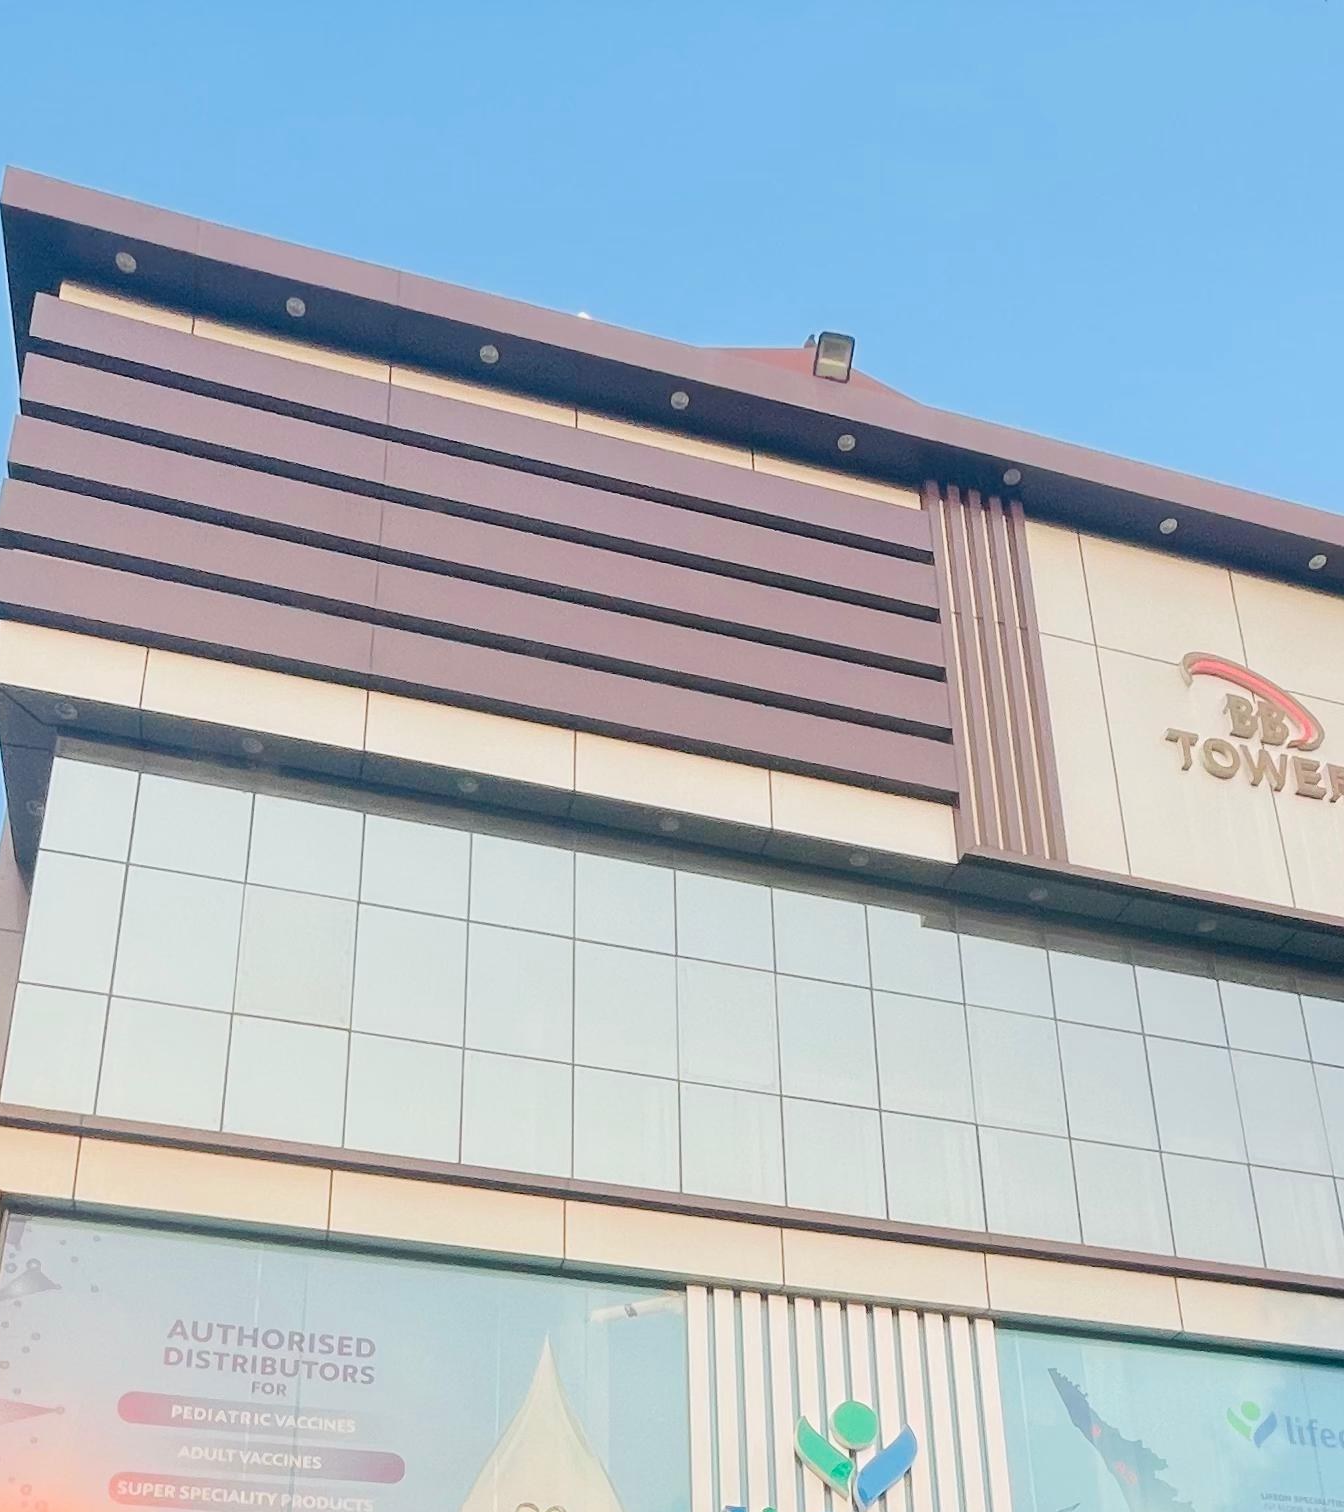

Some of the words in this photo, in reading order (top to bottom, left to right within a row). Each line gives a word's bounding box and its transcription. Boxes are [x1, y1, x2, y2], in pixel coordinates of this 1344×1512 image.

[166, 1318, 377, 1358] AUTHORISED
[162, 1346, 376, 1385] DISTRIBUTORS
[251, 1380, 288, 1397] FOR
[170, 1404, 271, 1427] PEDIATRIC
[273, 1414, 357, 1433] VACCINES
[176, 1445, 238, 1463] ADULT
[239, 1450, 323, 1469] VACCINES
[116, 1480, 176, 1499] SUPER
[179, 1485, 279, 1507] SPECIALITY
[280, 1494, 375, 1512] PRODUCTS
